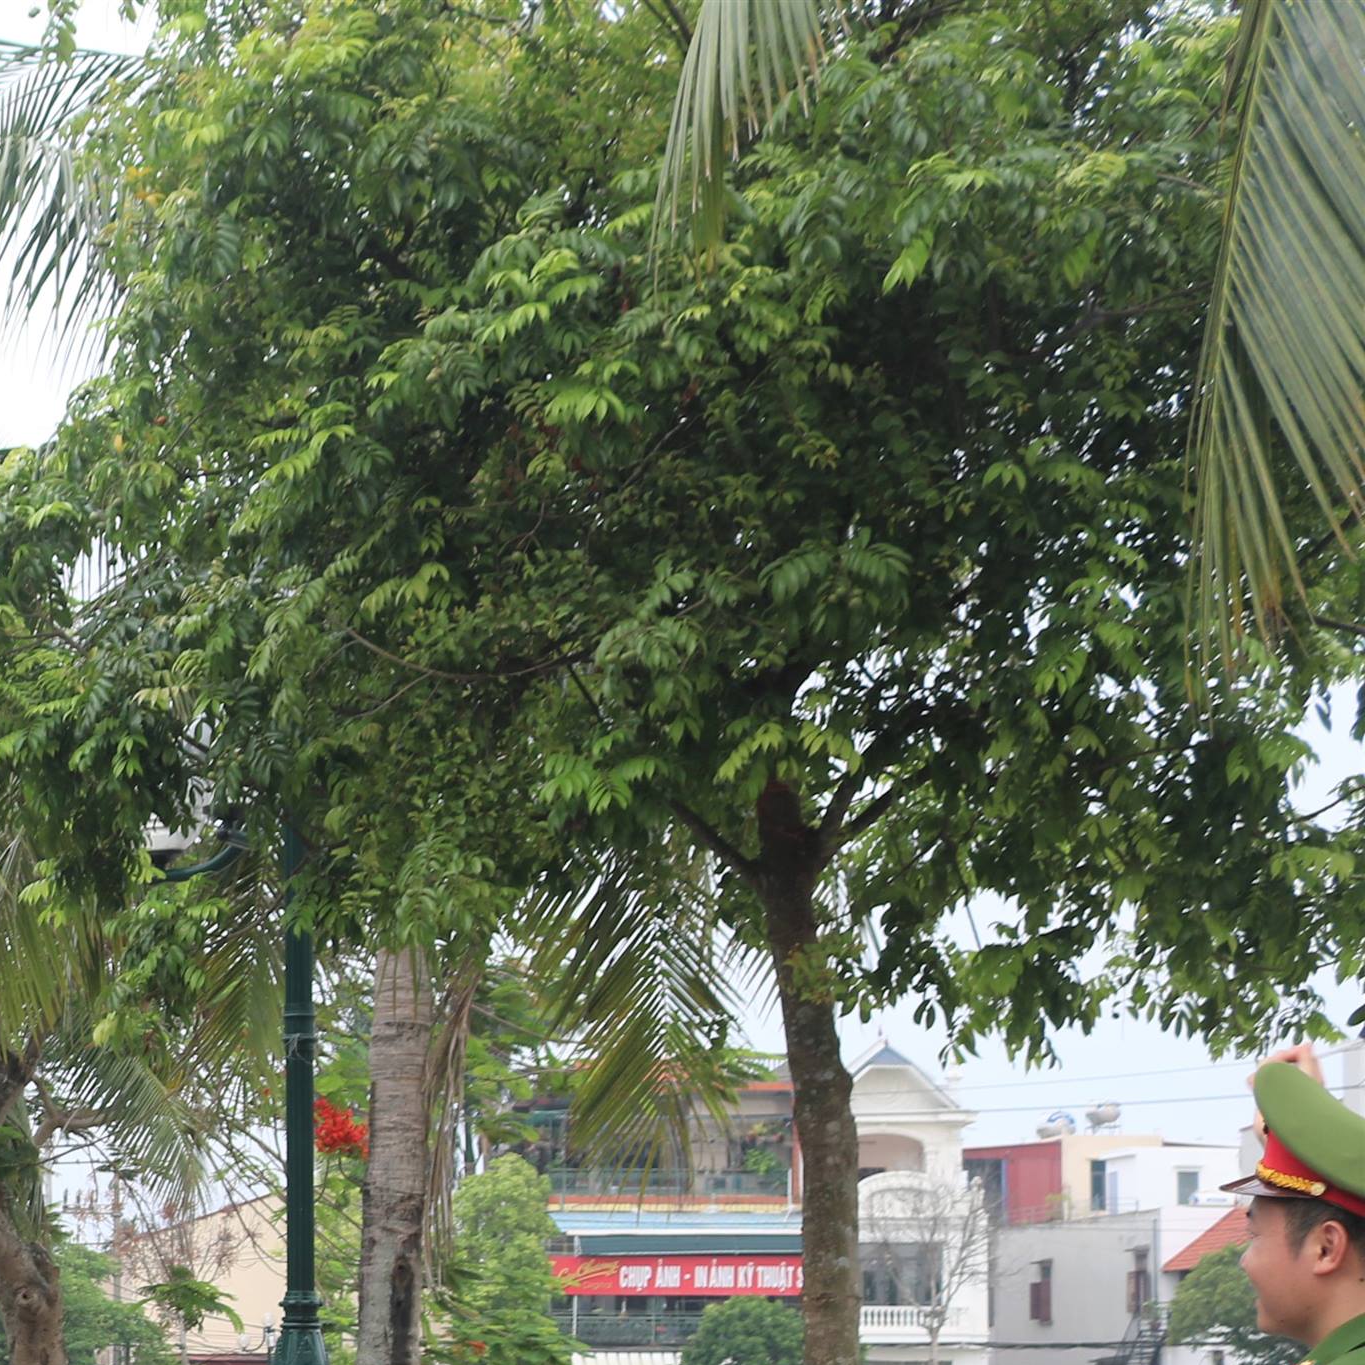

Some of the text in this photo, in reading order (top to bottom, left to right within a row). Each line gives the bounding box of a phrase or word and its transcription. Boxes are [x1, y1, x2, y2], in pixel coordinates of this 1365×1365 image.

[619, 1265, 652, 1292] CHỤP
[654, 1258, 681, 1288] ẢNH
[694, 1265, 708, 1288] IN
[709, 1258, 735, 1288] ẢNH
[737, 1262, 754, 1288] KỸ
[756, 1261, 795, 1292] THUẬT
